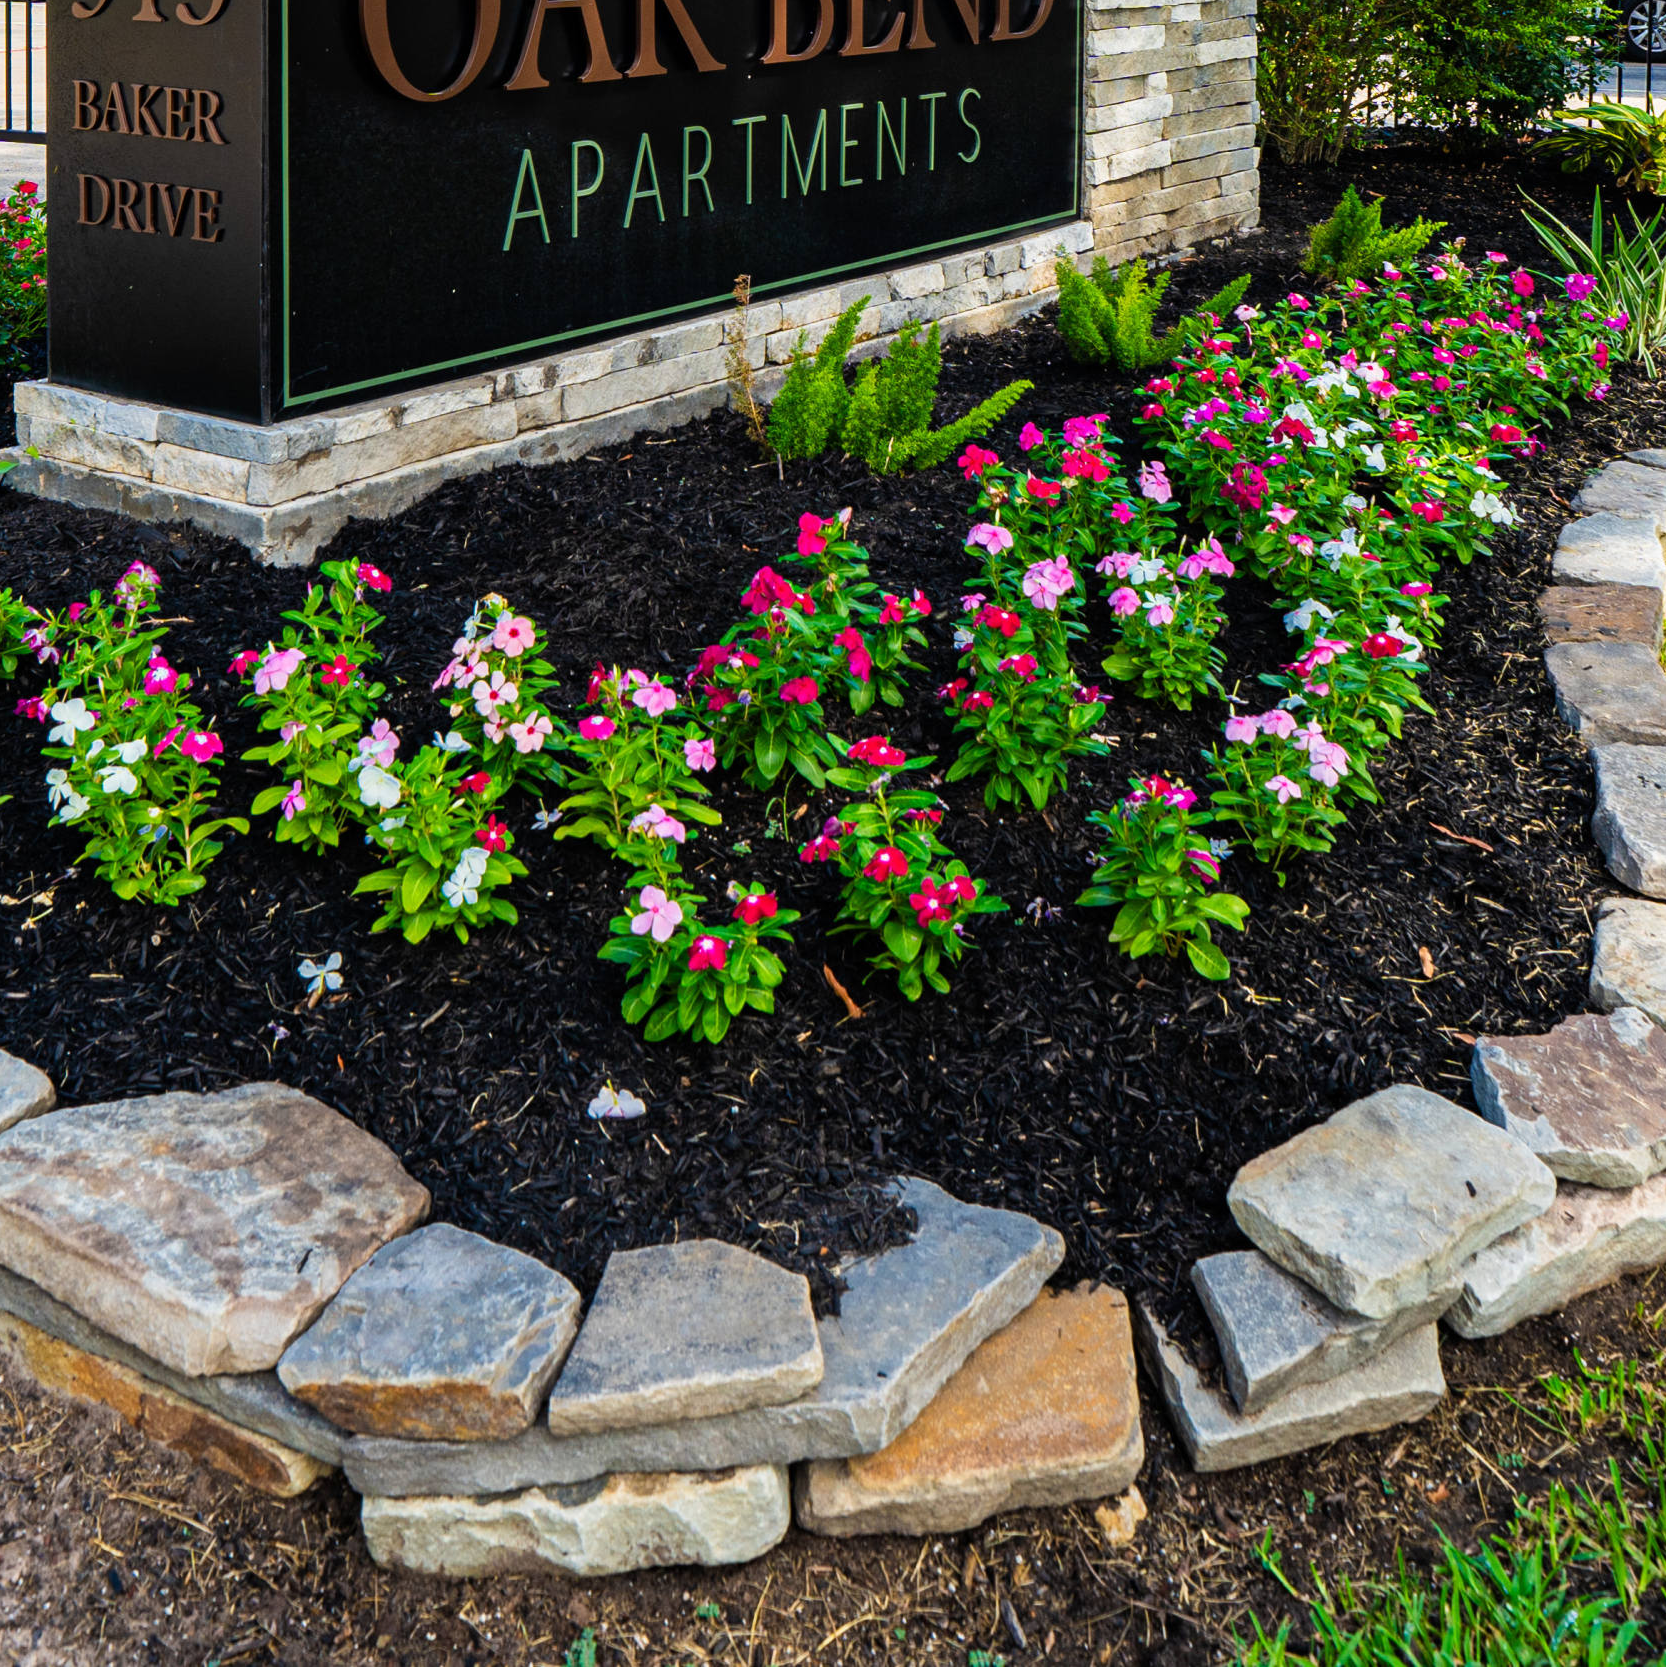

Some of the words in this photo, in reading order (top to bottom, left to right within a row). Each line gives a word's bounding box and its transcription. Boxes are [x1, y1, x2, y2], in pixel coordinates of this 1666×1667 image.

[71, 80, 229, 145] BAKER
[503, 88, 981, 251] APARTMENTS
[77, 174, 221, 243] DRIVE
